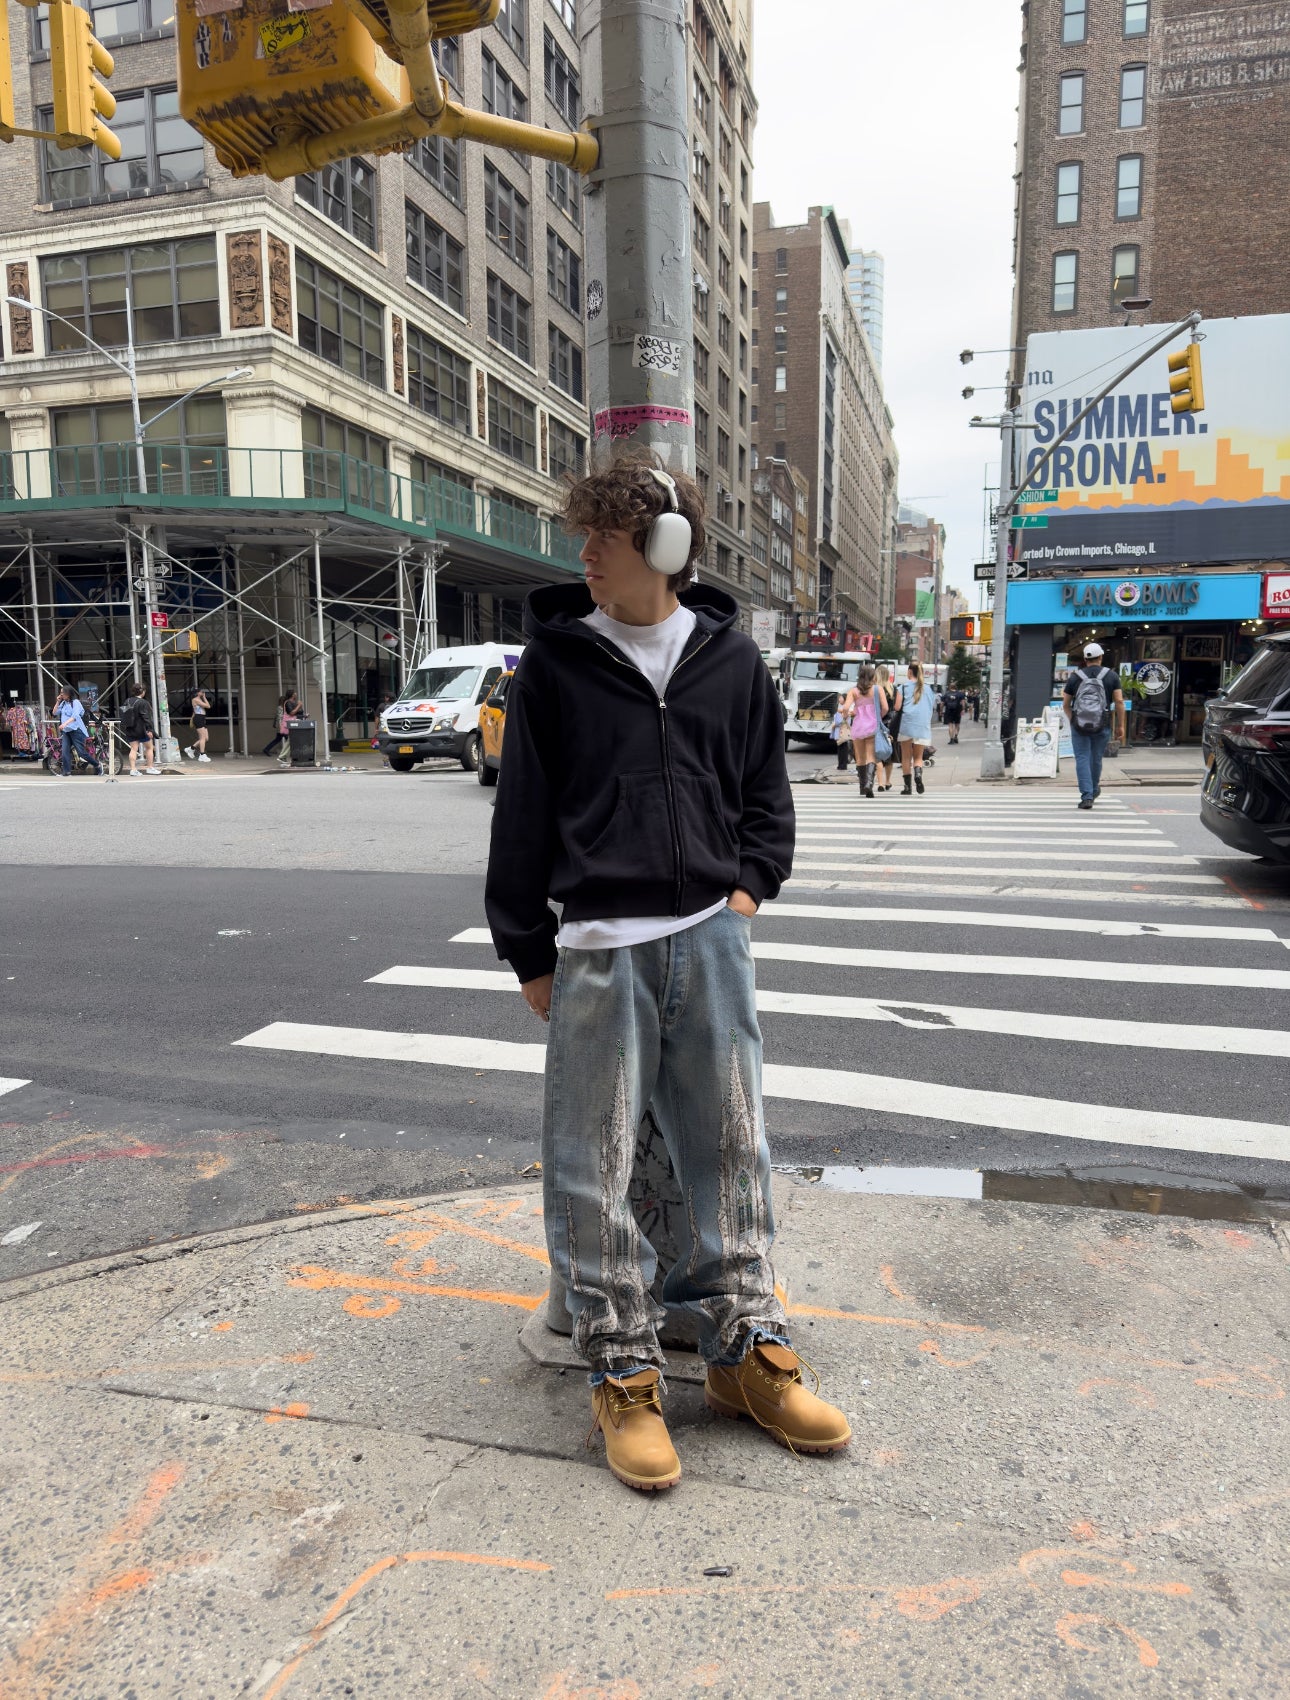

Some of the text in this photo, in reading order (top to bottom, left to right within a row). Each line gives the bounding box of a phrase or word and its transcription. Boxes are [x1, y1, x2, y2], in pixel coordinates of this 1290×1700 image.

[1028, 369, 1053, 386] na
[1027, 441, 1166, 489] ORONA.
[1014, 491, 1045, 502] ASHION
[1020, 517, 1027, 527] 7
[1023, 542, 1156, 559] orted by Crown Imports, Chicago, IL
[1062, 581, 1201, 607] PLAYA BOWLS
[389, 703, 440, 714] FedEx
